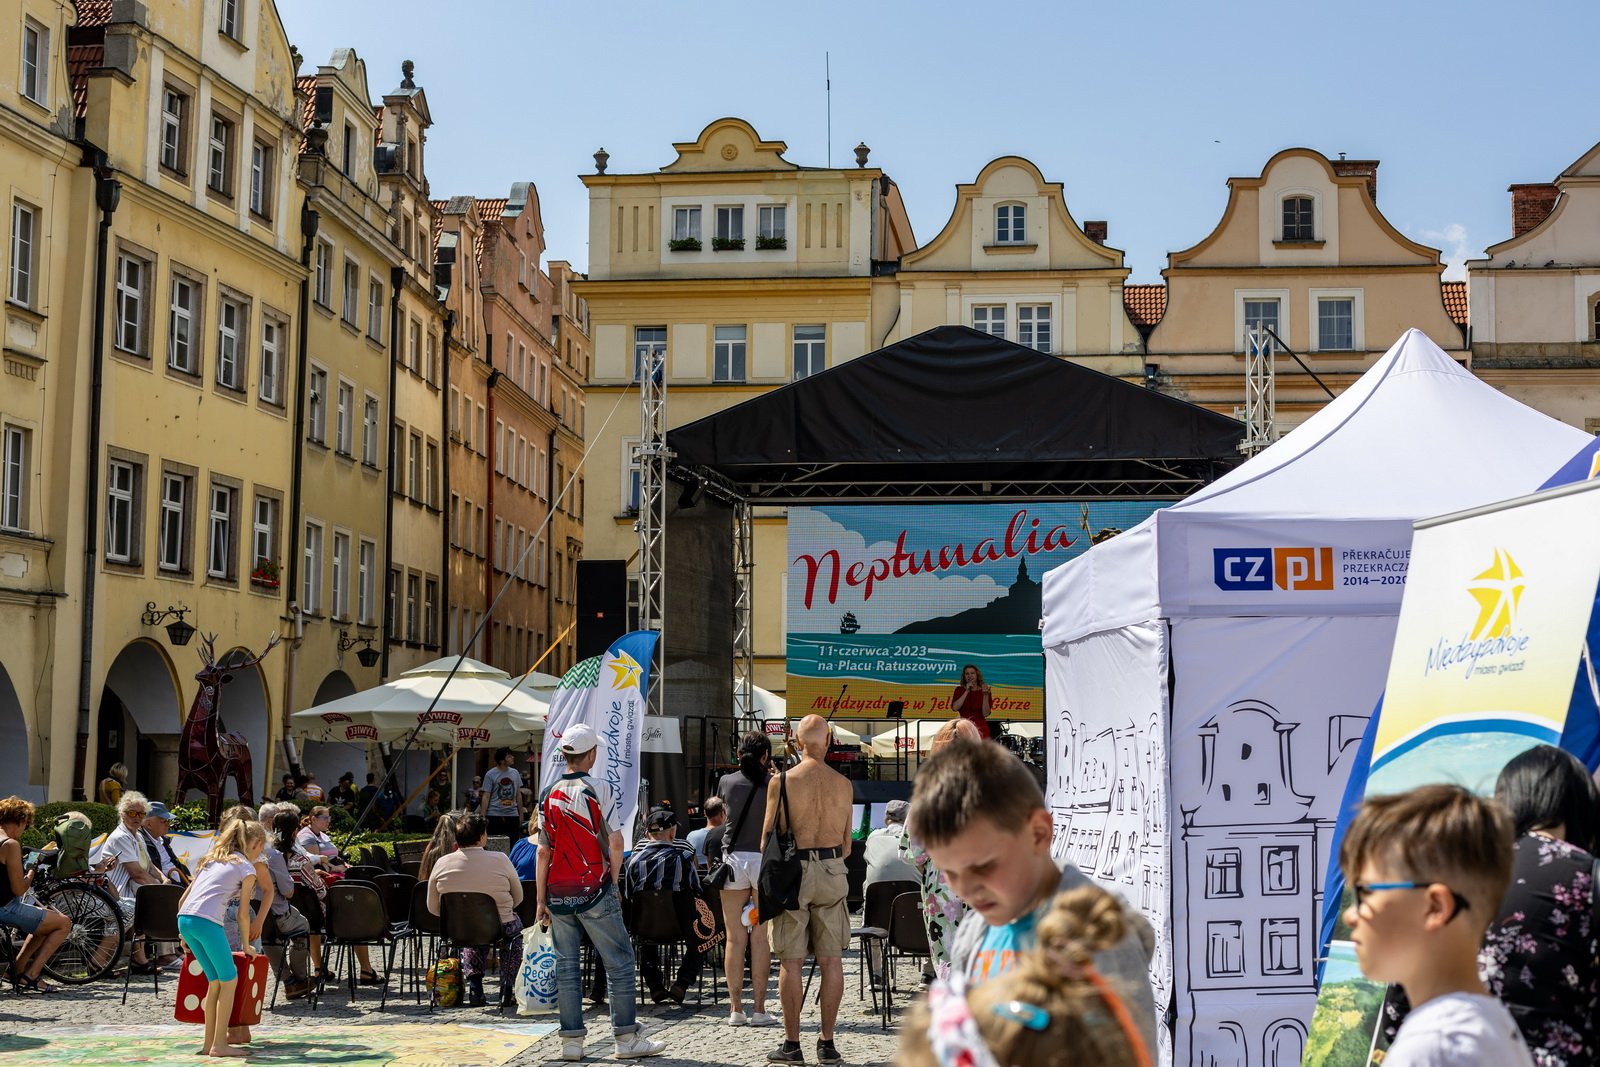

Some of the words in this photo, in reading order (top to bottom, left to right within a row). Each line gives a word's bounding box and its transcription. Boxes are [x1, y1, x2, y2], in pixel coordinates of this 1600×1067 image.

[793, 509, 1079, 610] Neptunalia
[893, 645, 928, 656] 2023
[817, 661, 834, 671] na
[837, 660, 872, 671] Placu
[875, 660, 957, 674] Ratuszowym
[811, 695, 910, 713] Międzyzdre
[912, 700, 925, 710] w
[991, 696, 1032, 711] Górze
[422, 712, 458, 722] YWIEC
[624, 733, 633, 760] miasto
